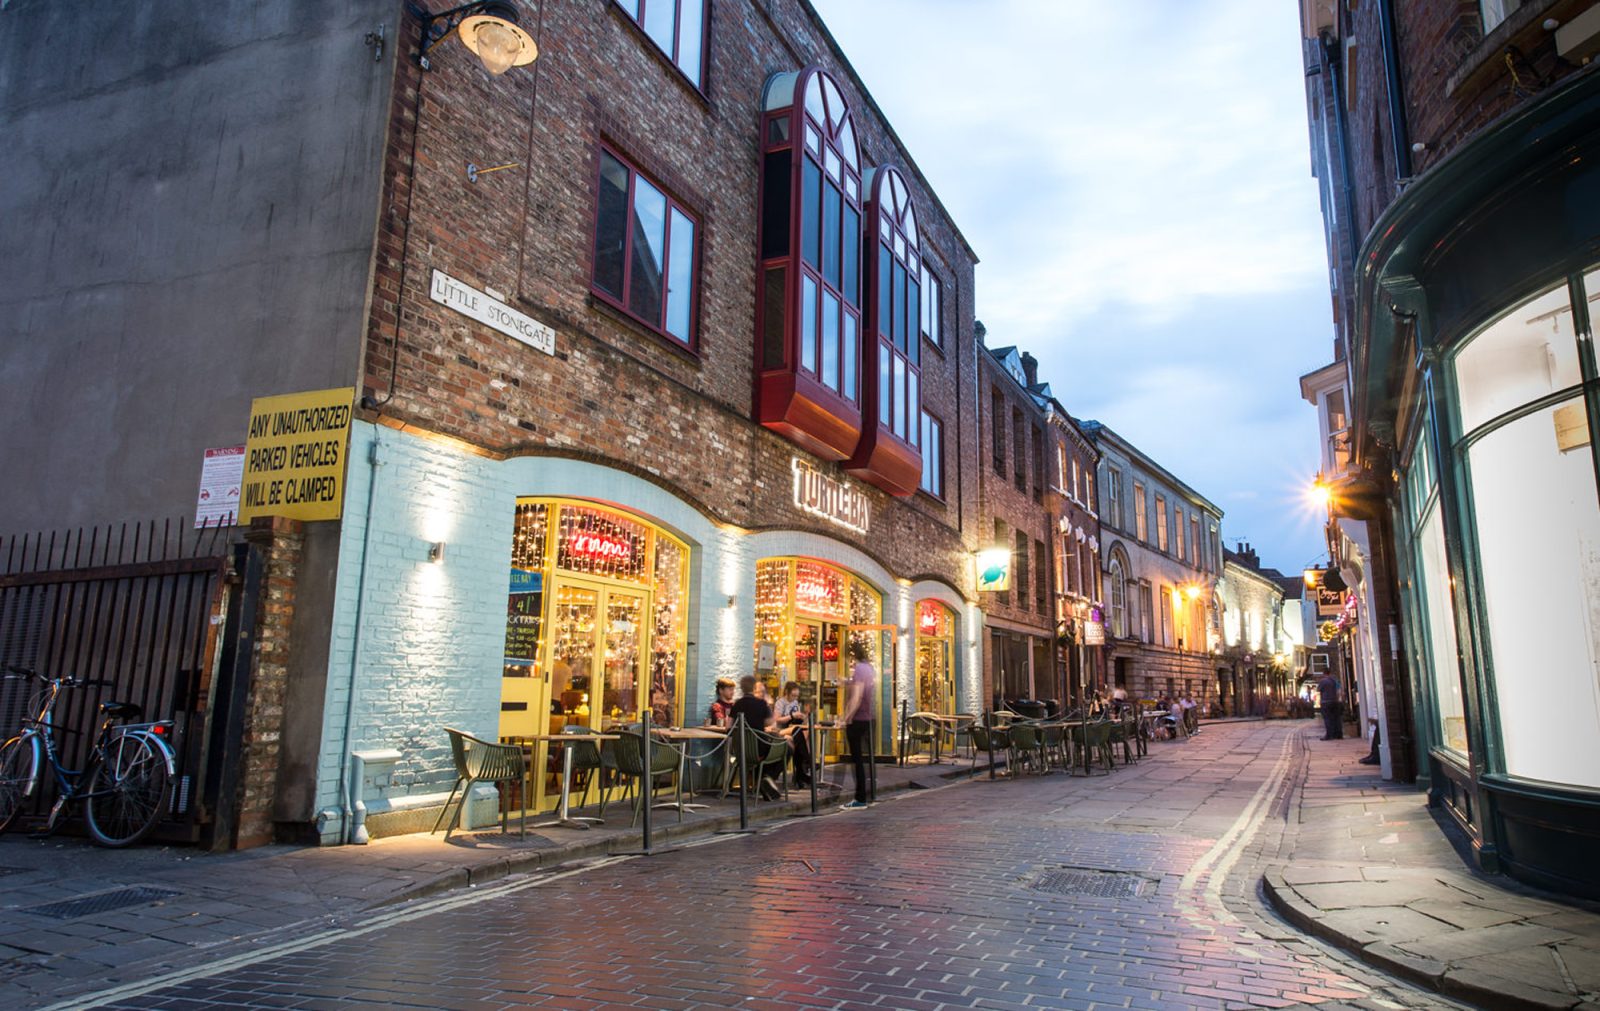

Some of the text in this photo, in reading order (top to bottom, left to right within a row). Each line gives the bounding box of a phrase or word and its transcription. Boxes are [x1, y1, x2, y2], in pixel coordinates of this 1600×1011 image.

[436, 279, 552, 347] LITTLE STONEGATE
[249, 405, 349, 439] ANY UNAUTHORIZED
[249, 440, 339, 472] PARKED VEHICLES
[246, 482, 265, 507] WILL
[268, 480, 283, 505] BE
[285, 476, 335, 504] CLAMPED
